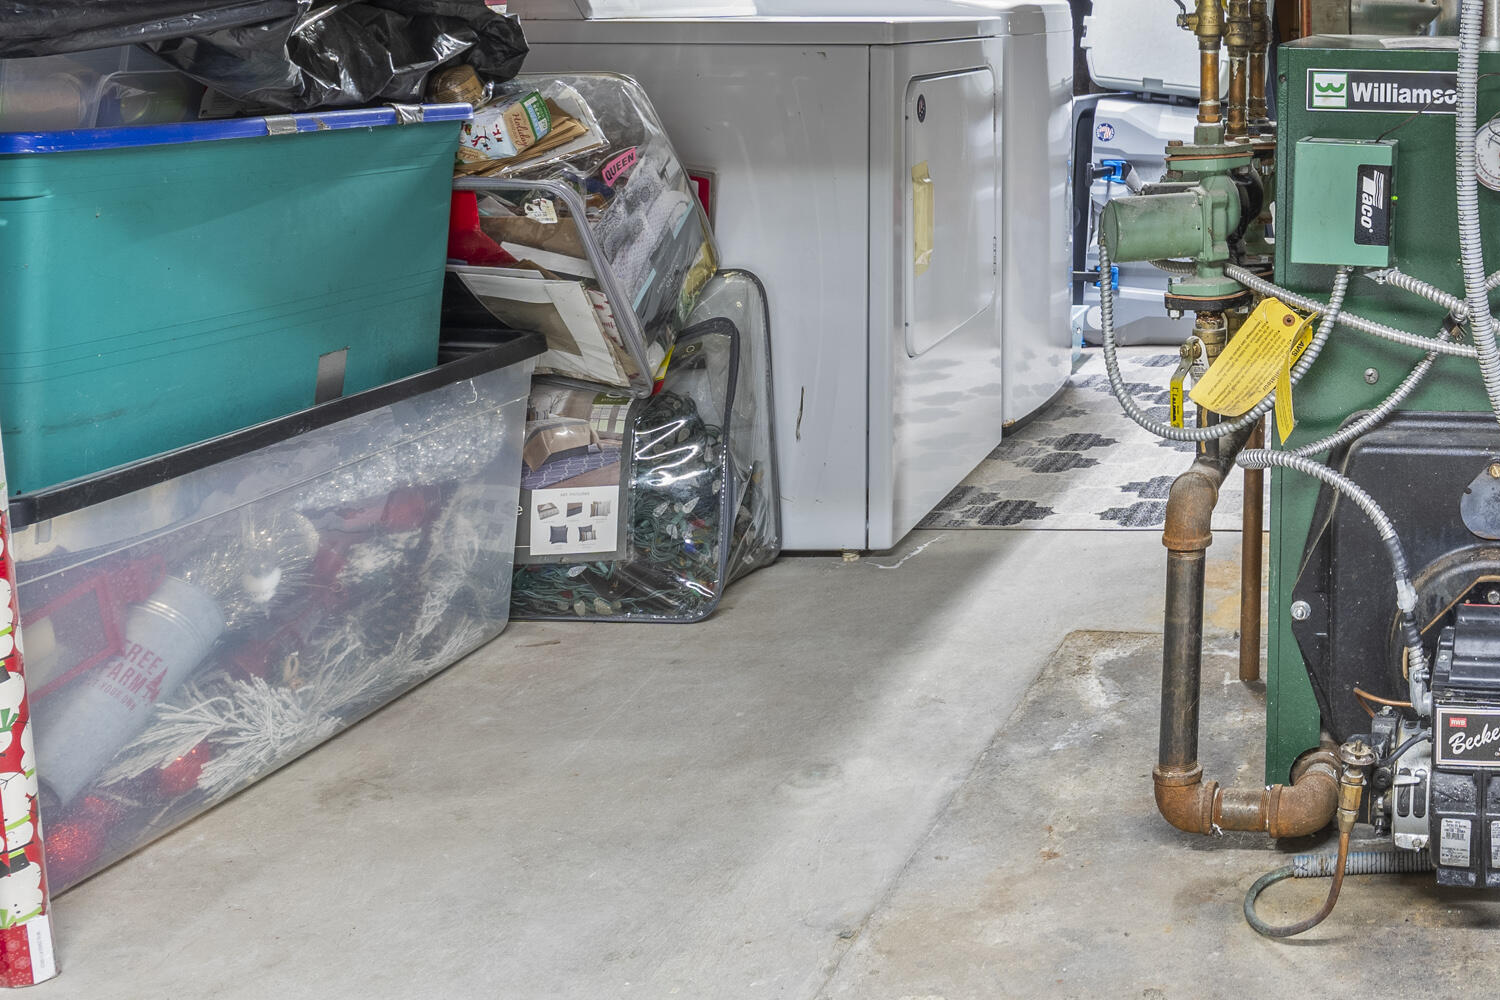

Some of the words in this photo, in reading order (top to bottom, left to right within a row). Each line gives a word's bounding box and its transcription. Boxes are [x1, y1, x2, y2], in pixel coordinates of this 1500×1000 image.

[1352, 82, 1458, 104] Williamso
[511, 112, 530, 147] Holiday
[604, 152, 636, 182] QUEEN
[1360, 169, 1386, 229] Taco
[1292, 340, 1305, 358] AVIS
